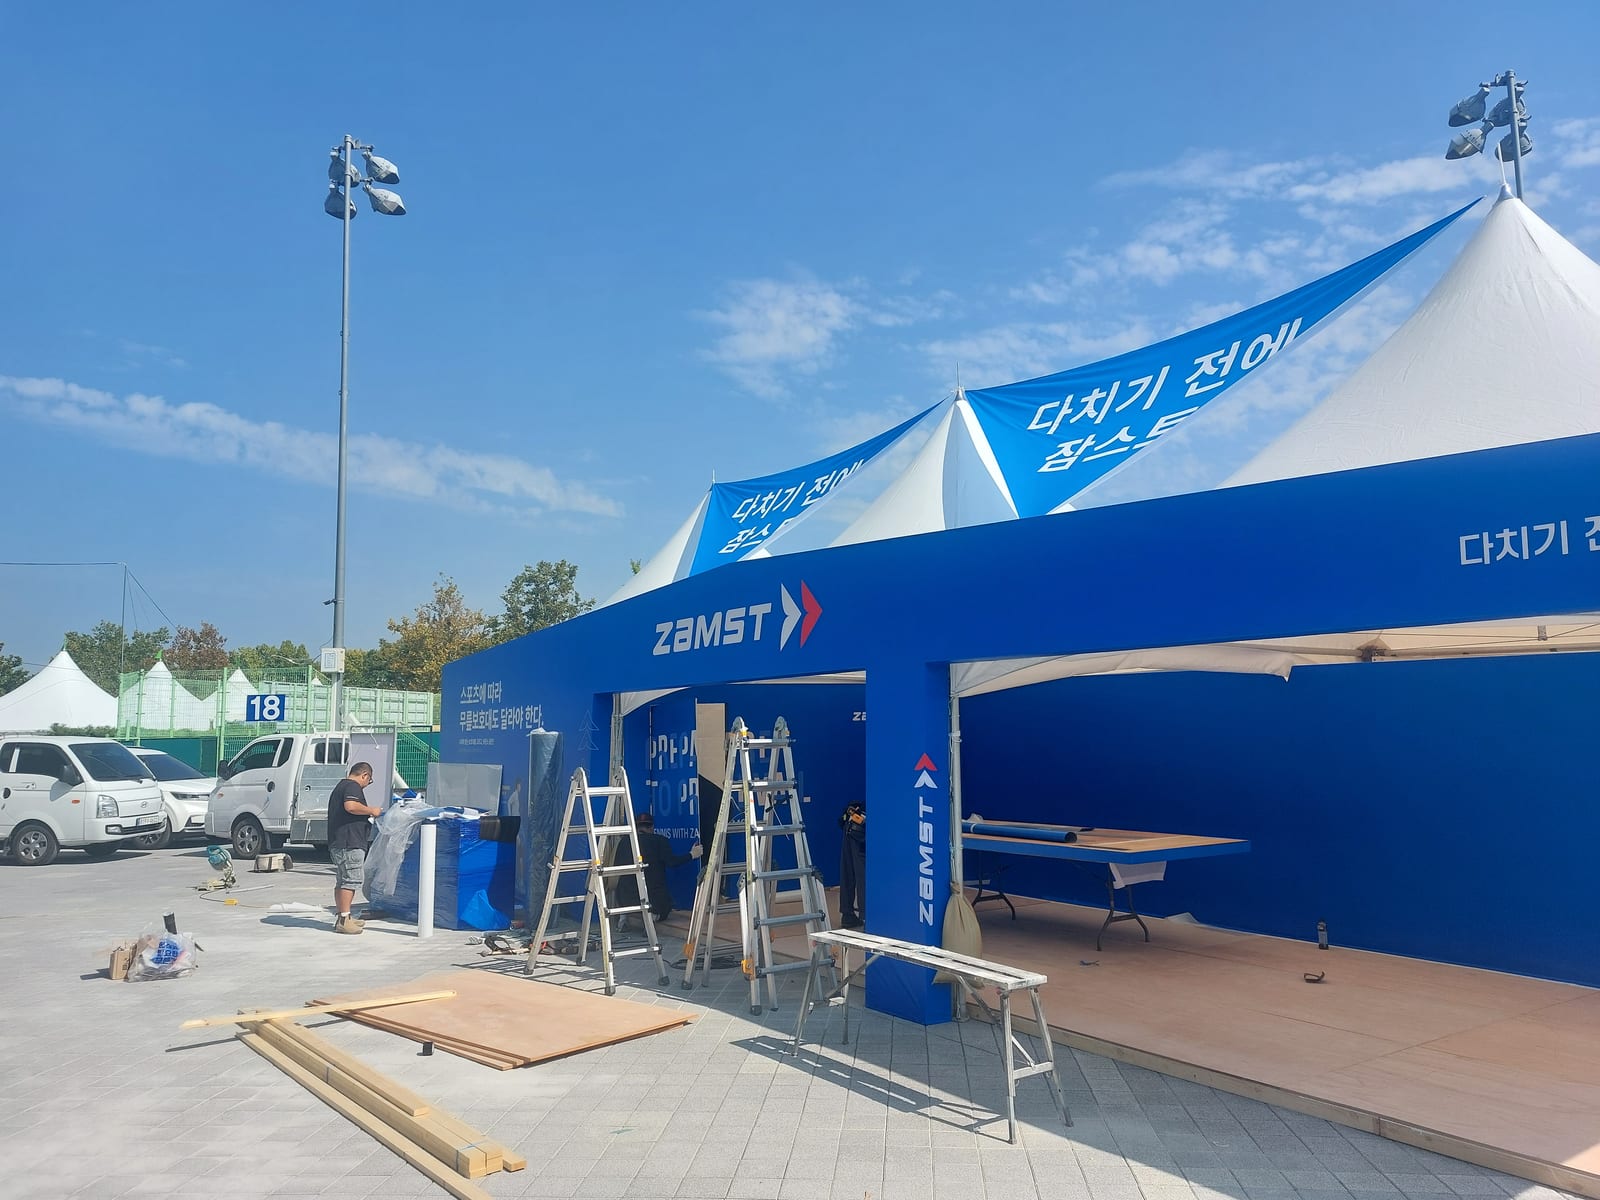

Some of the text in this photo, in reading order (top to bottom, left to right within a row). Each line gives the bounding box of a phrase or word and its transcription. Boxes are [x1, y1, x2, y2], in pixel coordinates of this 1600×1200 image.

[1027, 317, 1303, 435] 다치기 전에
[732, 481, 805, 523] 다치기
[718, 515, 796, 554] 잠스
[1459, 520, 1569, 565] 다치기
[250, 695, 281, 720] 18
[460, 680, 502, 705] 스포츠에 따라
[500, 705, 524, 730] 달라야
[672, 828, 689, 839] WITH
